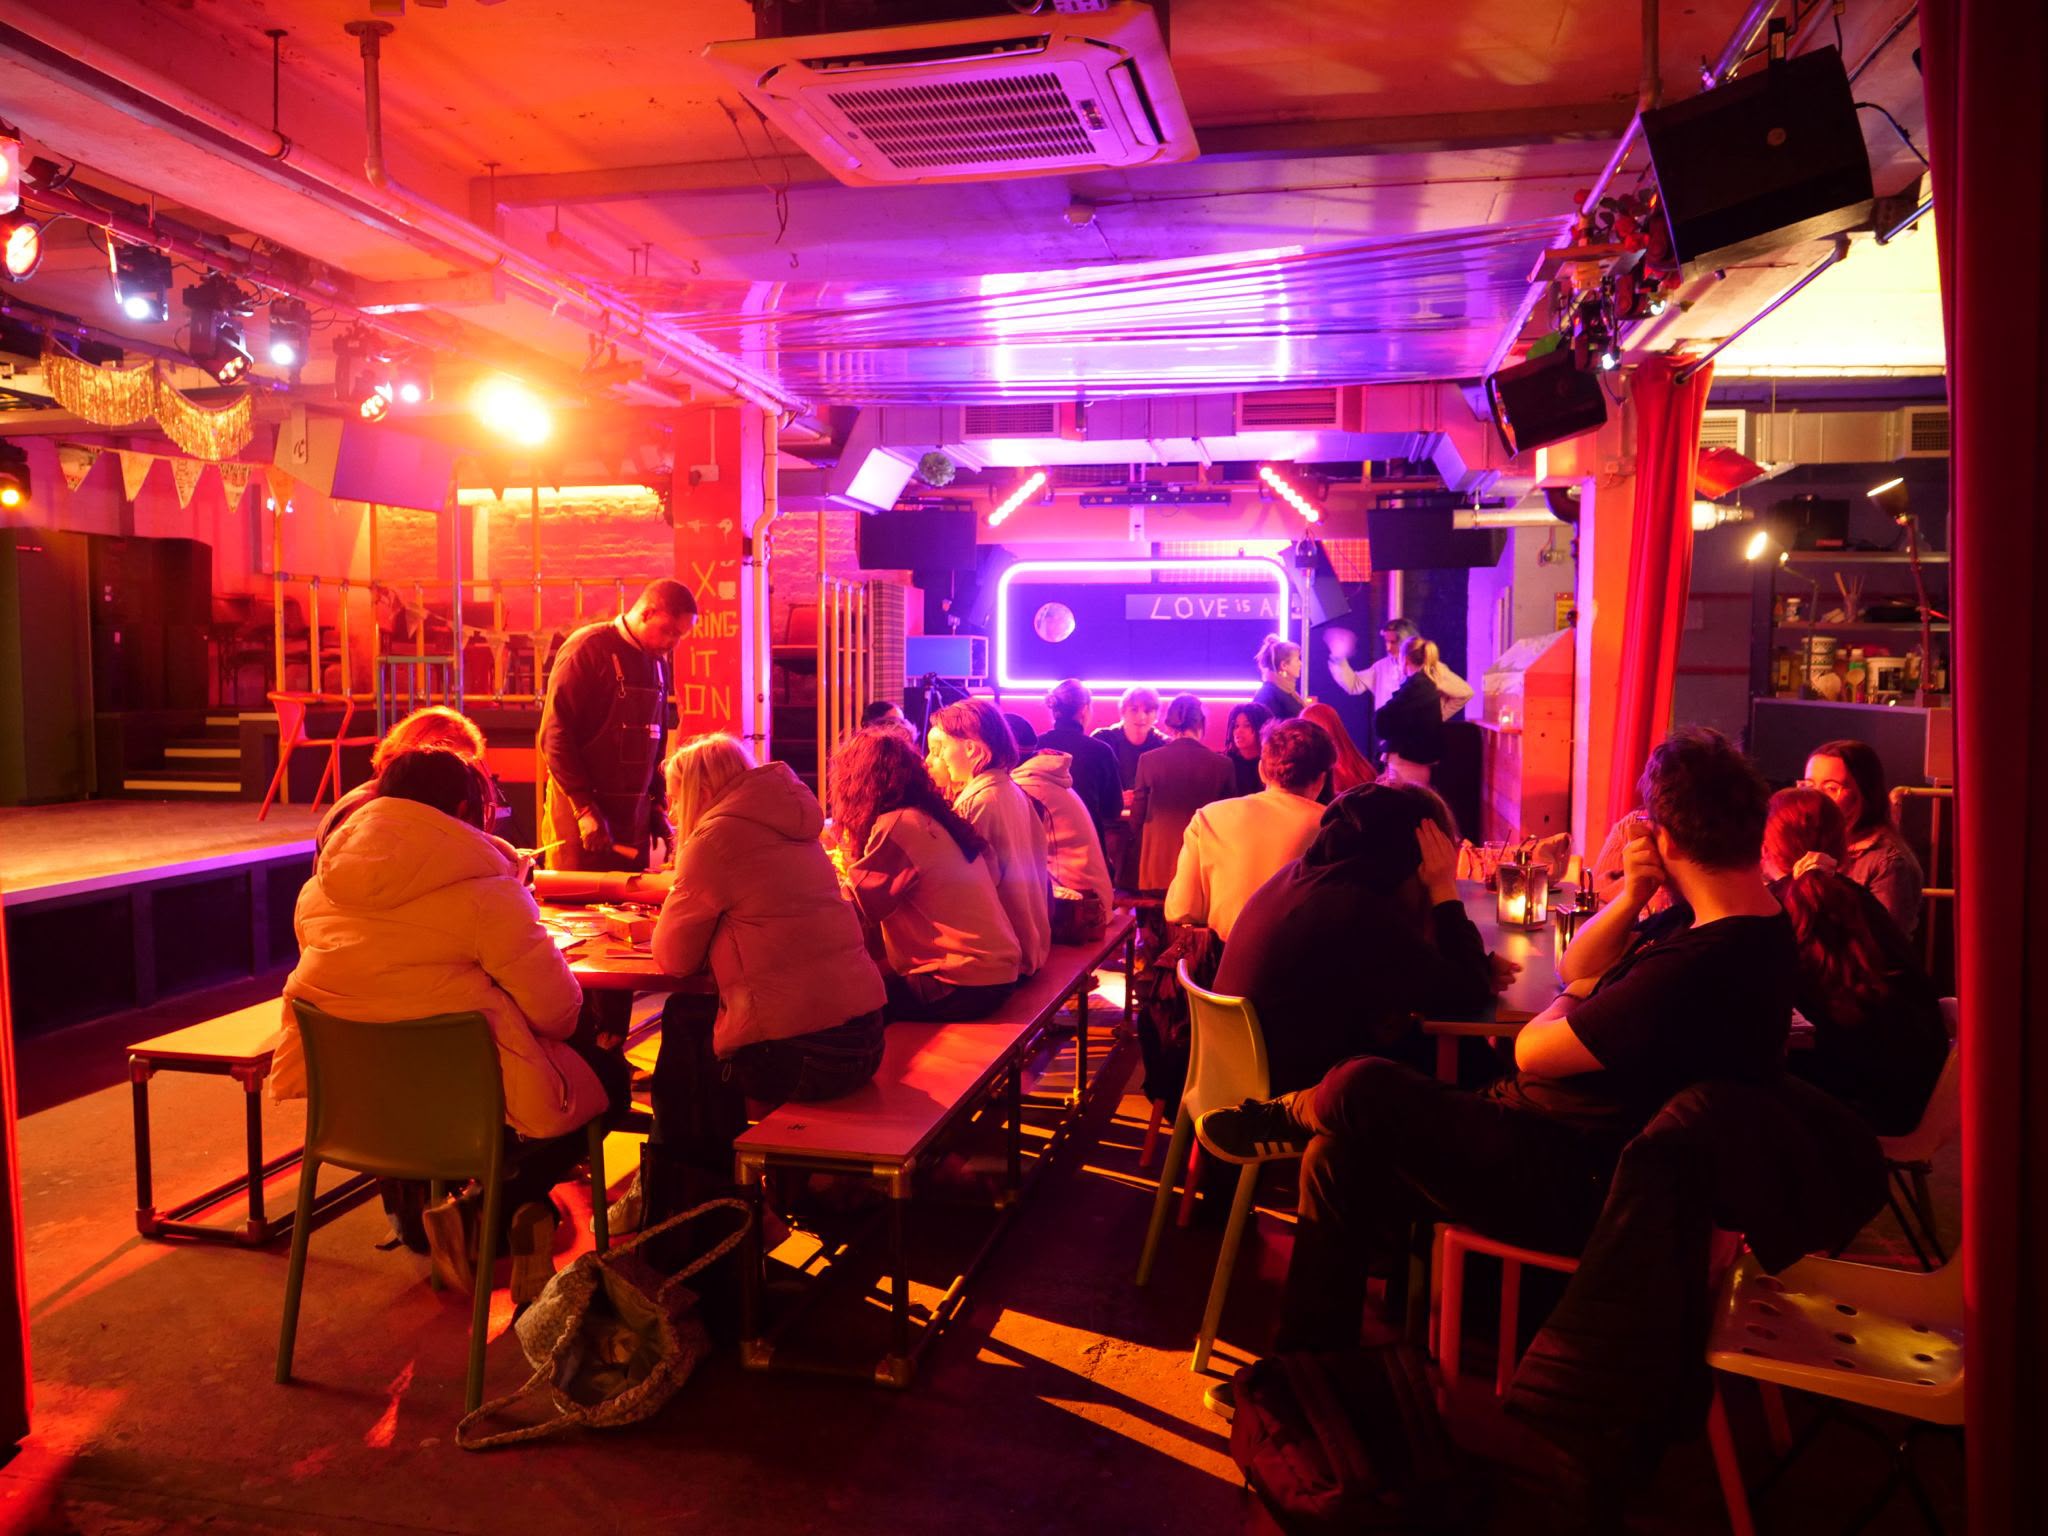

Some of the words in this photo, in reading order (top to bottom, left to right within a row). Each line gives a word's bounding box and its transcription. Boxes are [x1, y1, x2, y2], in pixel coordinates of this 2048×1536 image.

[1150, 596, 1230, 619] LOVE
[691, 609, 739, 640] RiNG
[684, 683, 731, 721] ON
